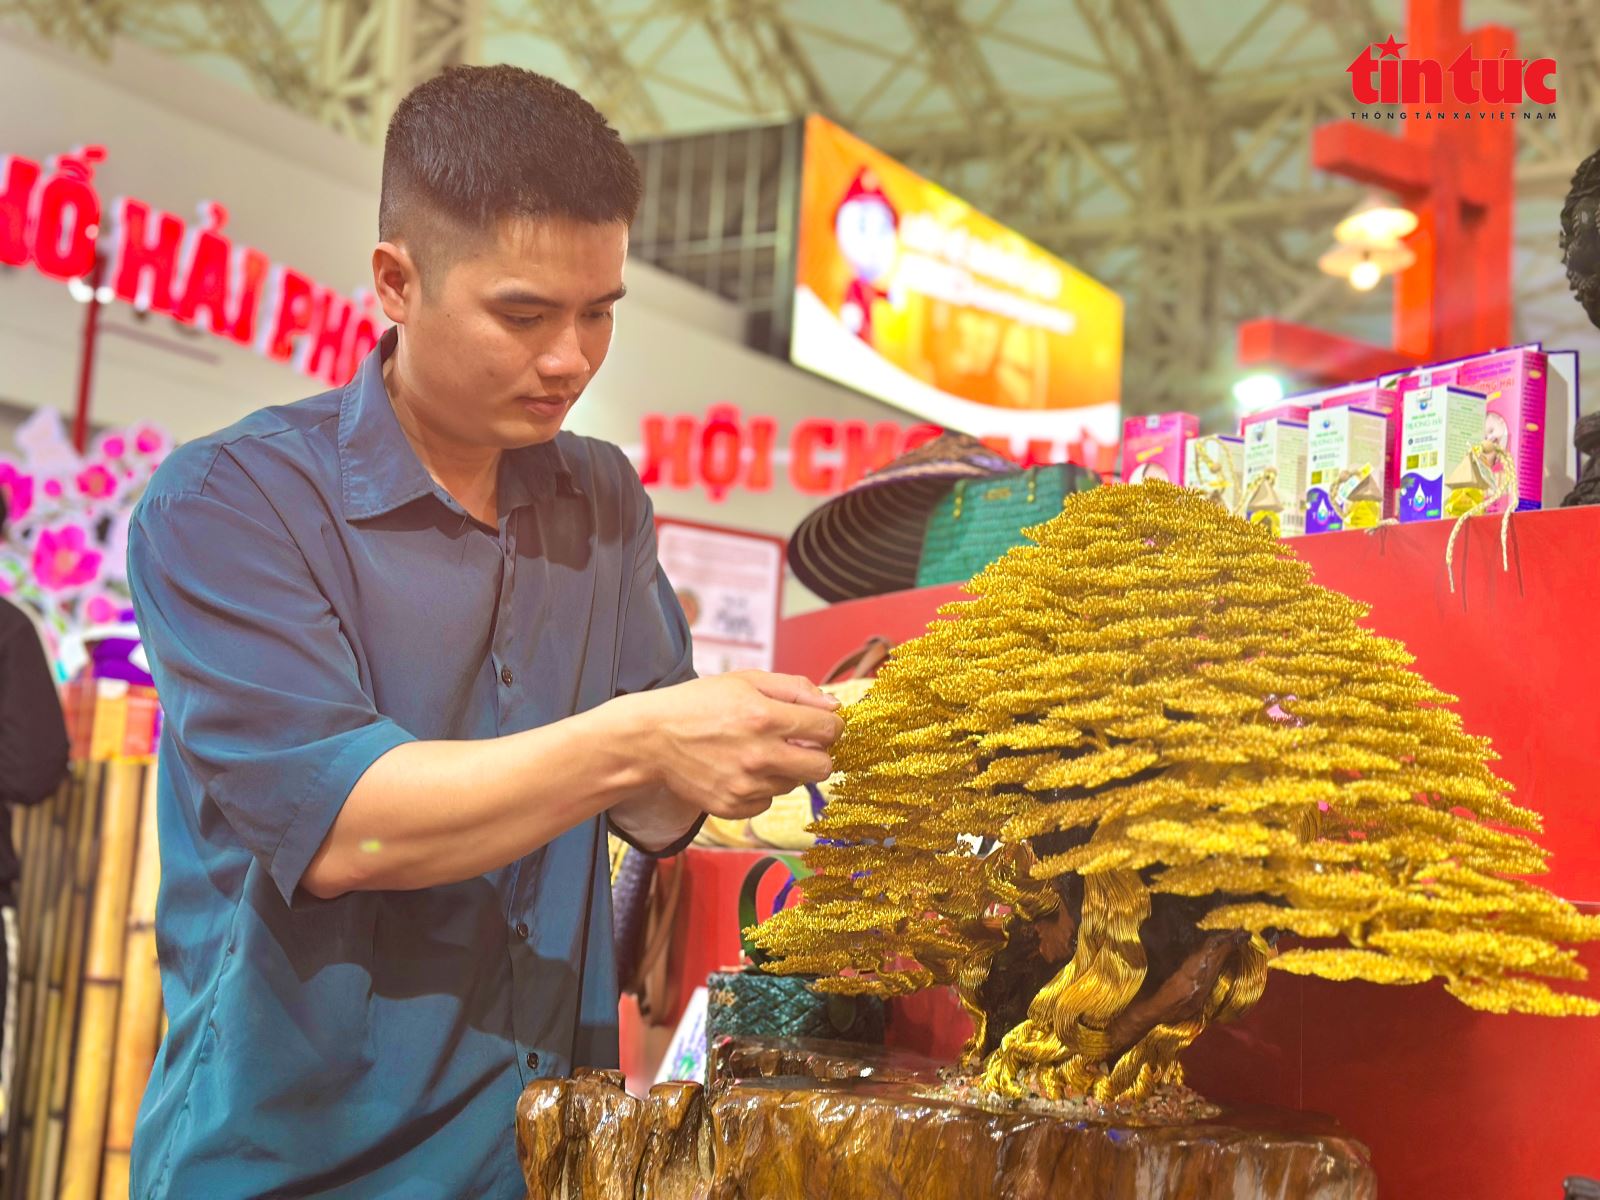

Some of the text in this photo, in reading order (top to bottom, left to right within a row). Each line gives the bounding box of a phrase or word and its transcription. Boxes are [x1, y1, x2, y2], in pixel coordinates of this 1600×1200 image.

[112, 197, 270, 349] HẢI
[639, 401, 777, 503] HỘI
[788, 416, 945, 495] CH
